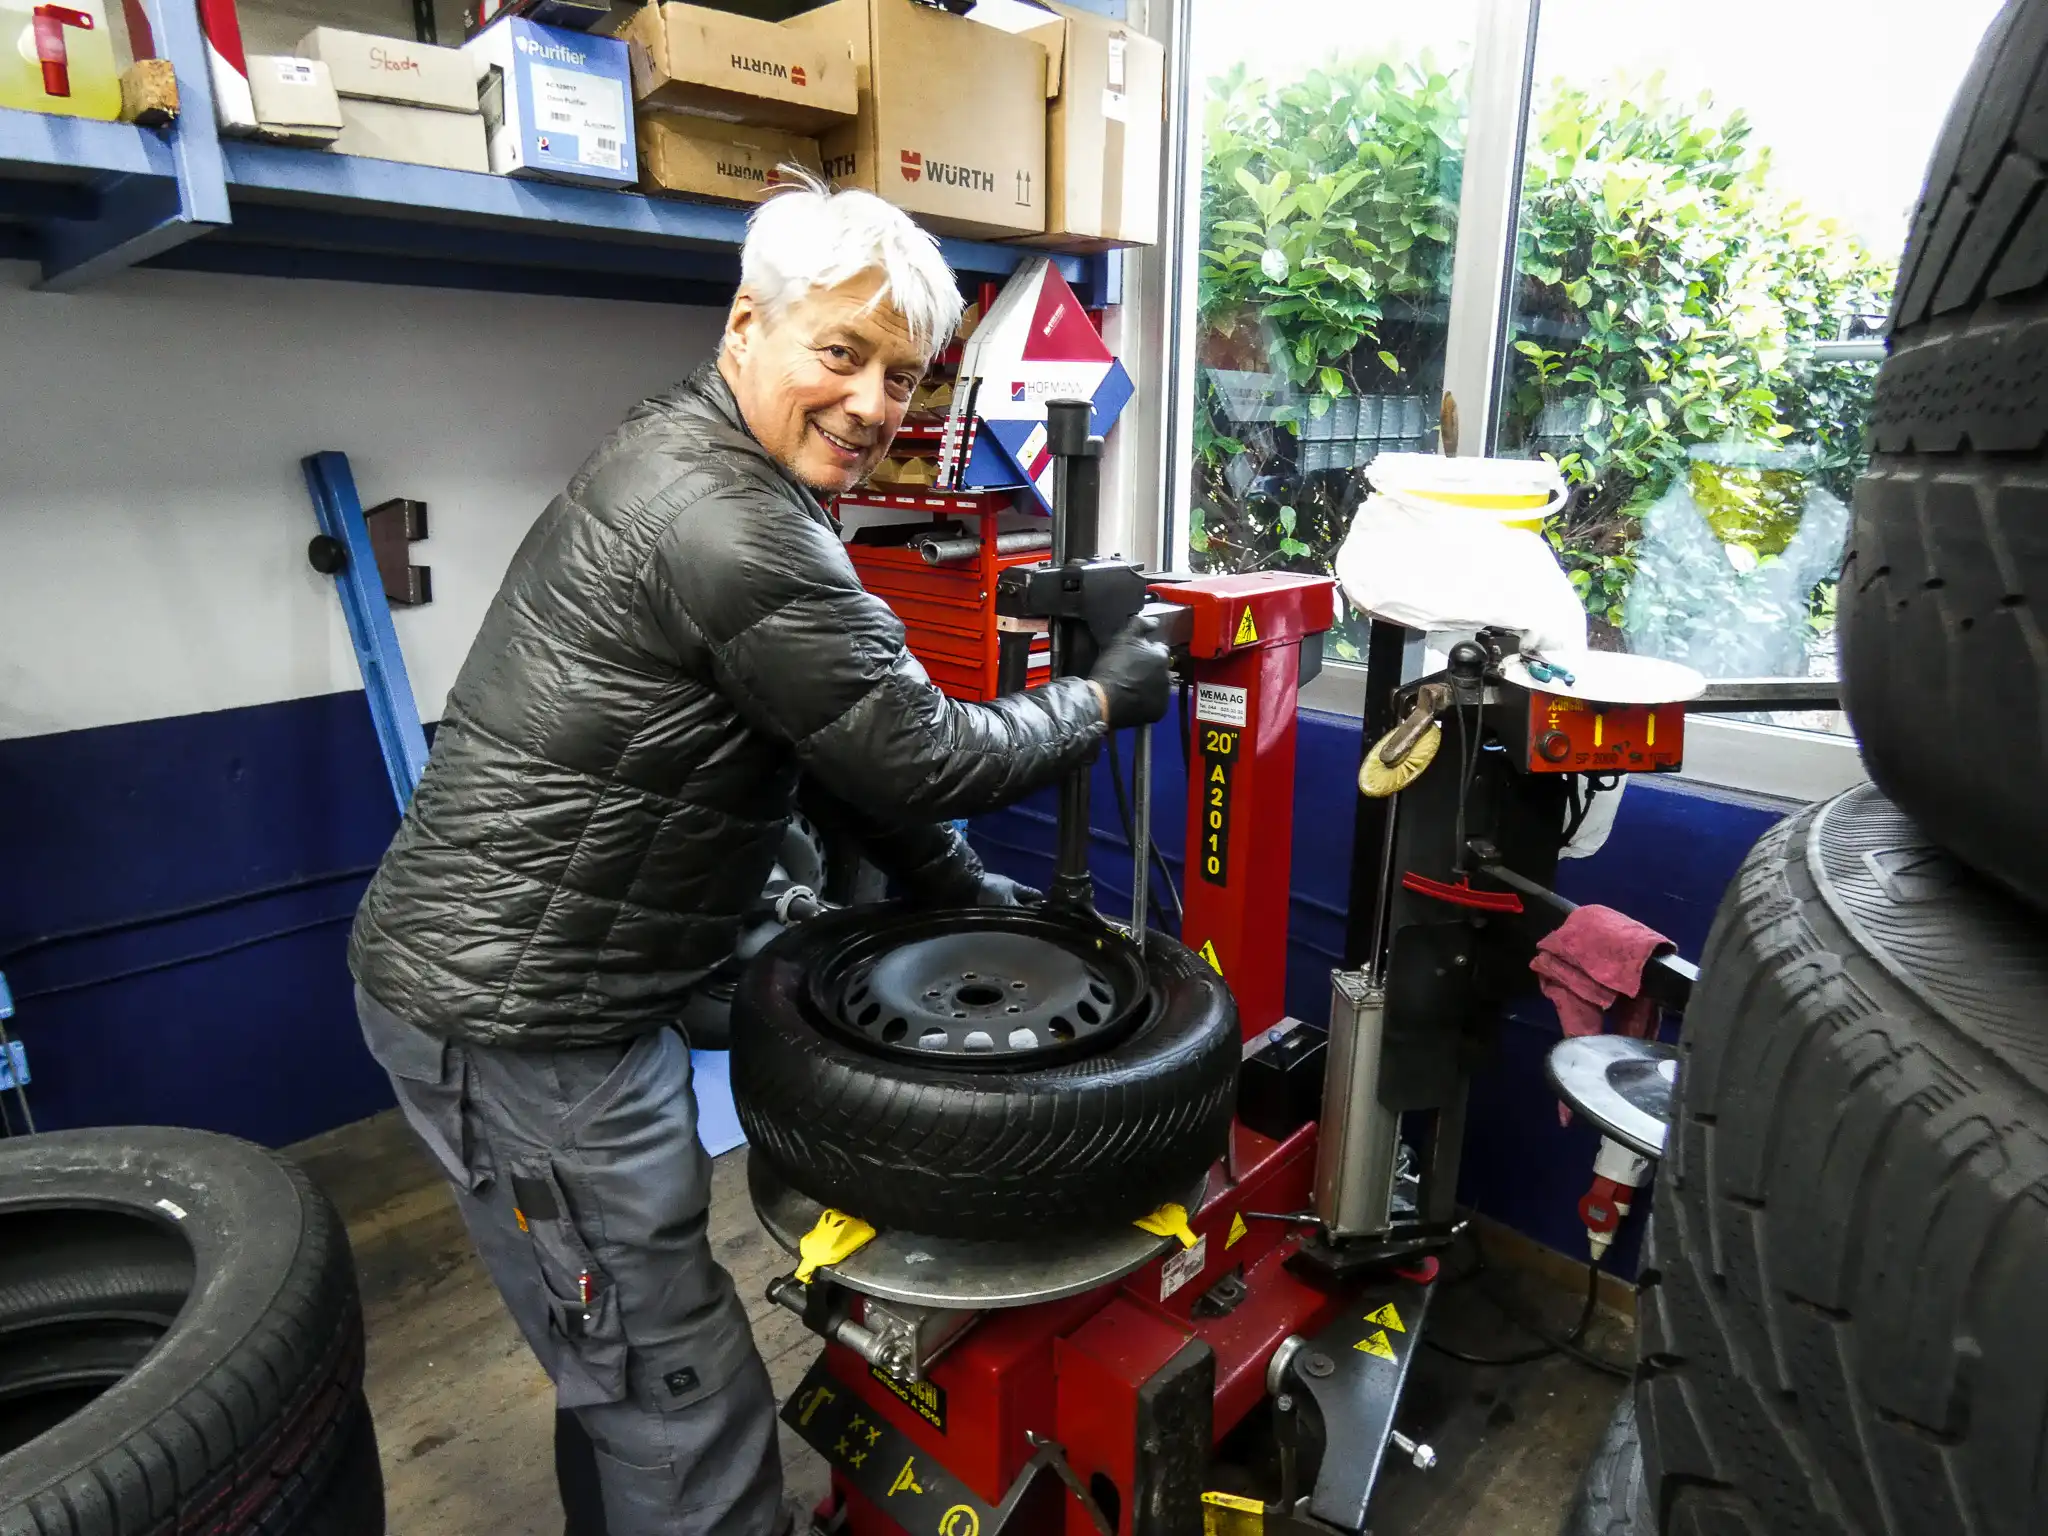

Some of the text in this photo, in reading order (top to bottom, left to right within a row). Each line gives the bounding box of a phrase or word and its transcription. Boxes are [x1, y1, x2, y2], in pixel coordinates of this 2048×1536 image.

[369, 47, 421, 76] Skoda
[528, 41, 587, 66] Purifier
[731, 54, 788, 79] WÜRTH
[716, 161, 765, 182] WÜRTH
[925, 160, 994, 193] WÜRTH
[1027, 381, 1084, 393] HOFMANN
[1199, 689, 1228, 702] WEMA
[1229, 694, 1244, 704] AG
[1206, 730, 1238, 755] 20"
[1207, 764, 1226, 876] A2010
